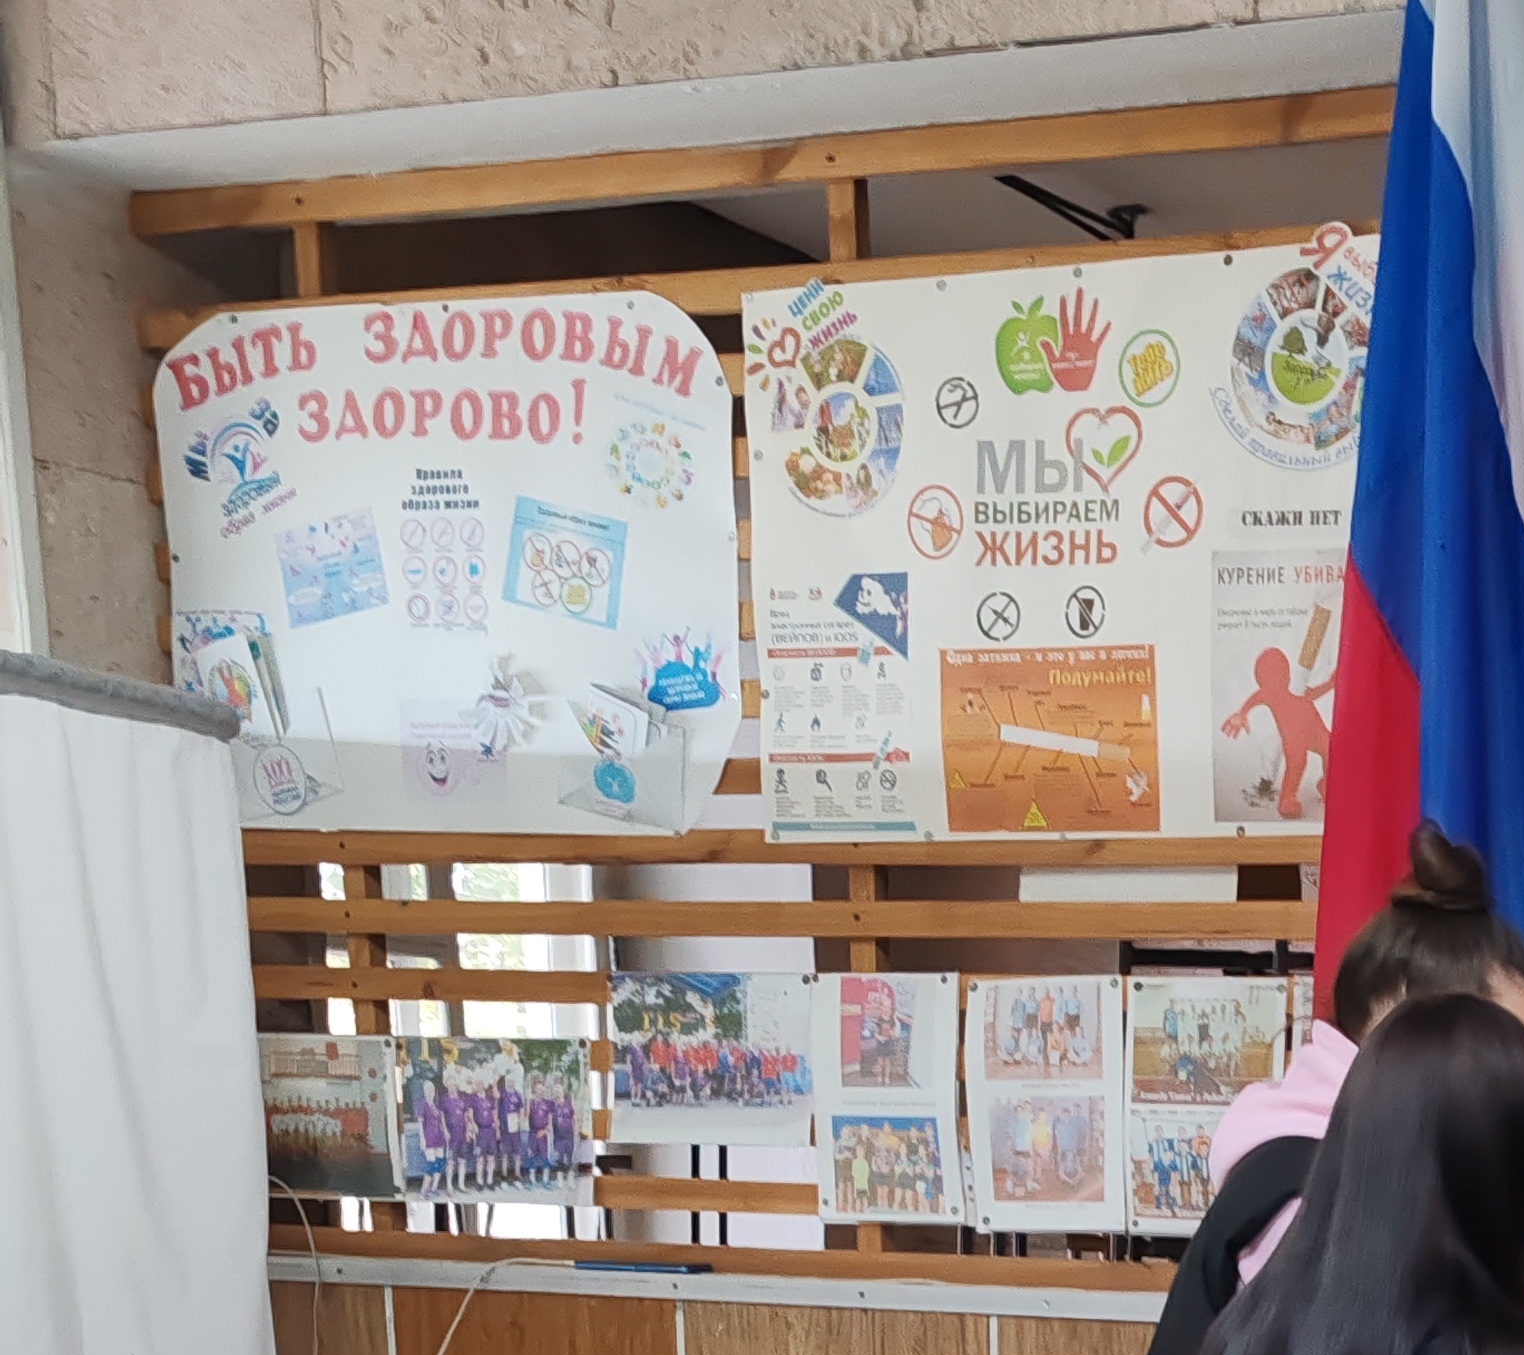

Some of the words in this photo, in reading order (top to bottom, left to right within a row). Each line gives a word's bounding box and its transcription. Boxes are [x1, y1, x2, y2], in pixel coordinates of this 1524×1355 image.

[788, 279, 825, 317] ЦЕНИ
[802, 291, 844, 332] СВОЮ
[809, 310, 858, 350] ЖИЗНЬ
[167, 321, 317, 411] БЫТЬ
[364, 309, 704, 398] ЗДОРОВЫМ
[298, 377, 587, 445] ЗДОРОВО!
[976, 437, 1083, 494] МЫ
[974, 499, 1120, 524] ВЫБИРАЕМ
[1309, 510, 1342, 526] НЕТ
[975, 530, 1118, 567] ЖИЗНЬ
[1217, 566, 1285, 585] КУРЕНИЕ
[1049, 665, 1151, 687] Подумайте!
